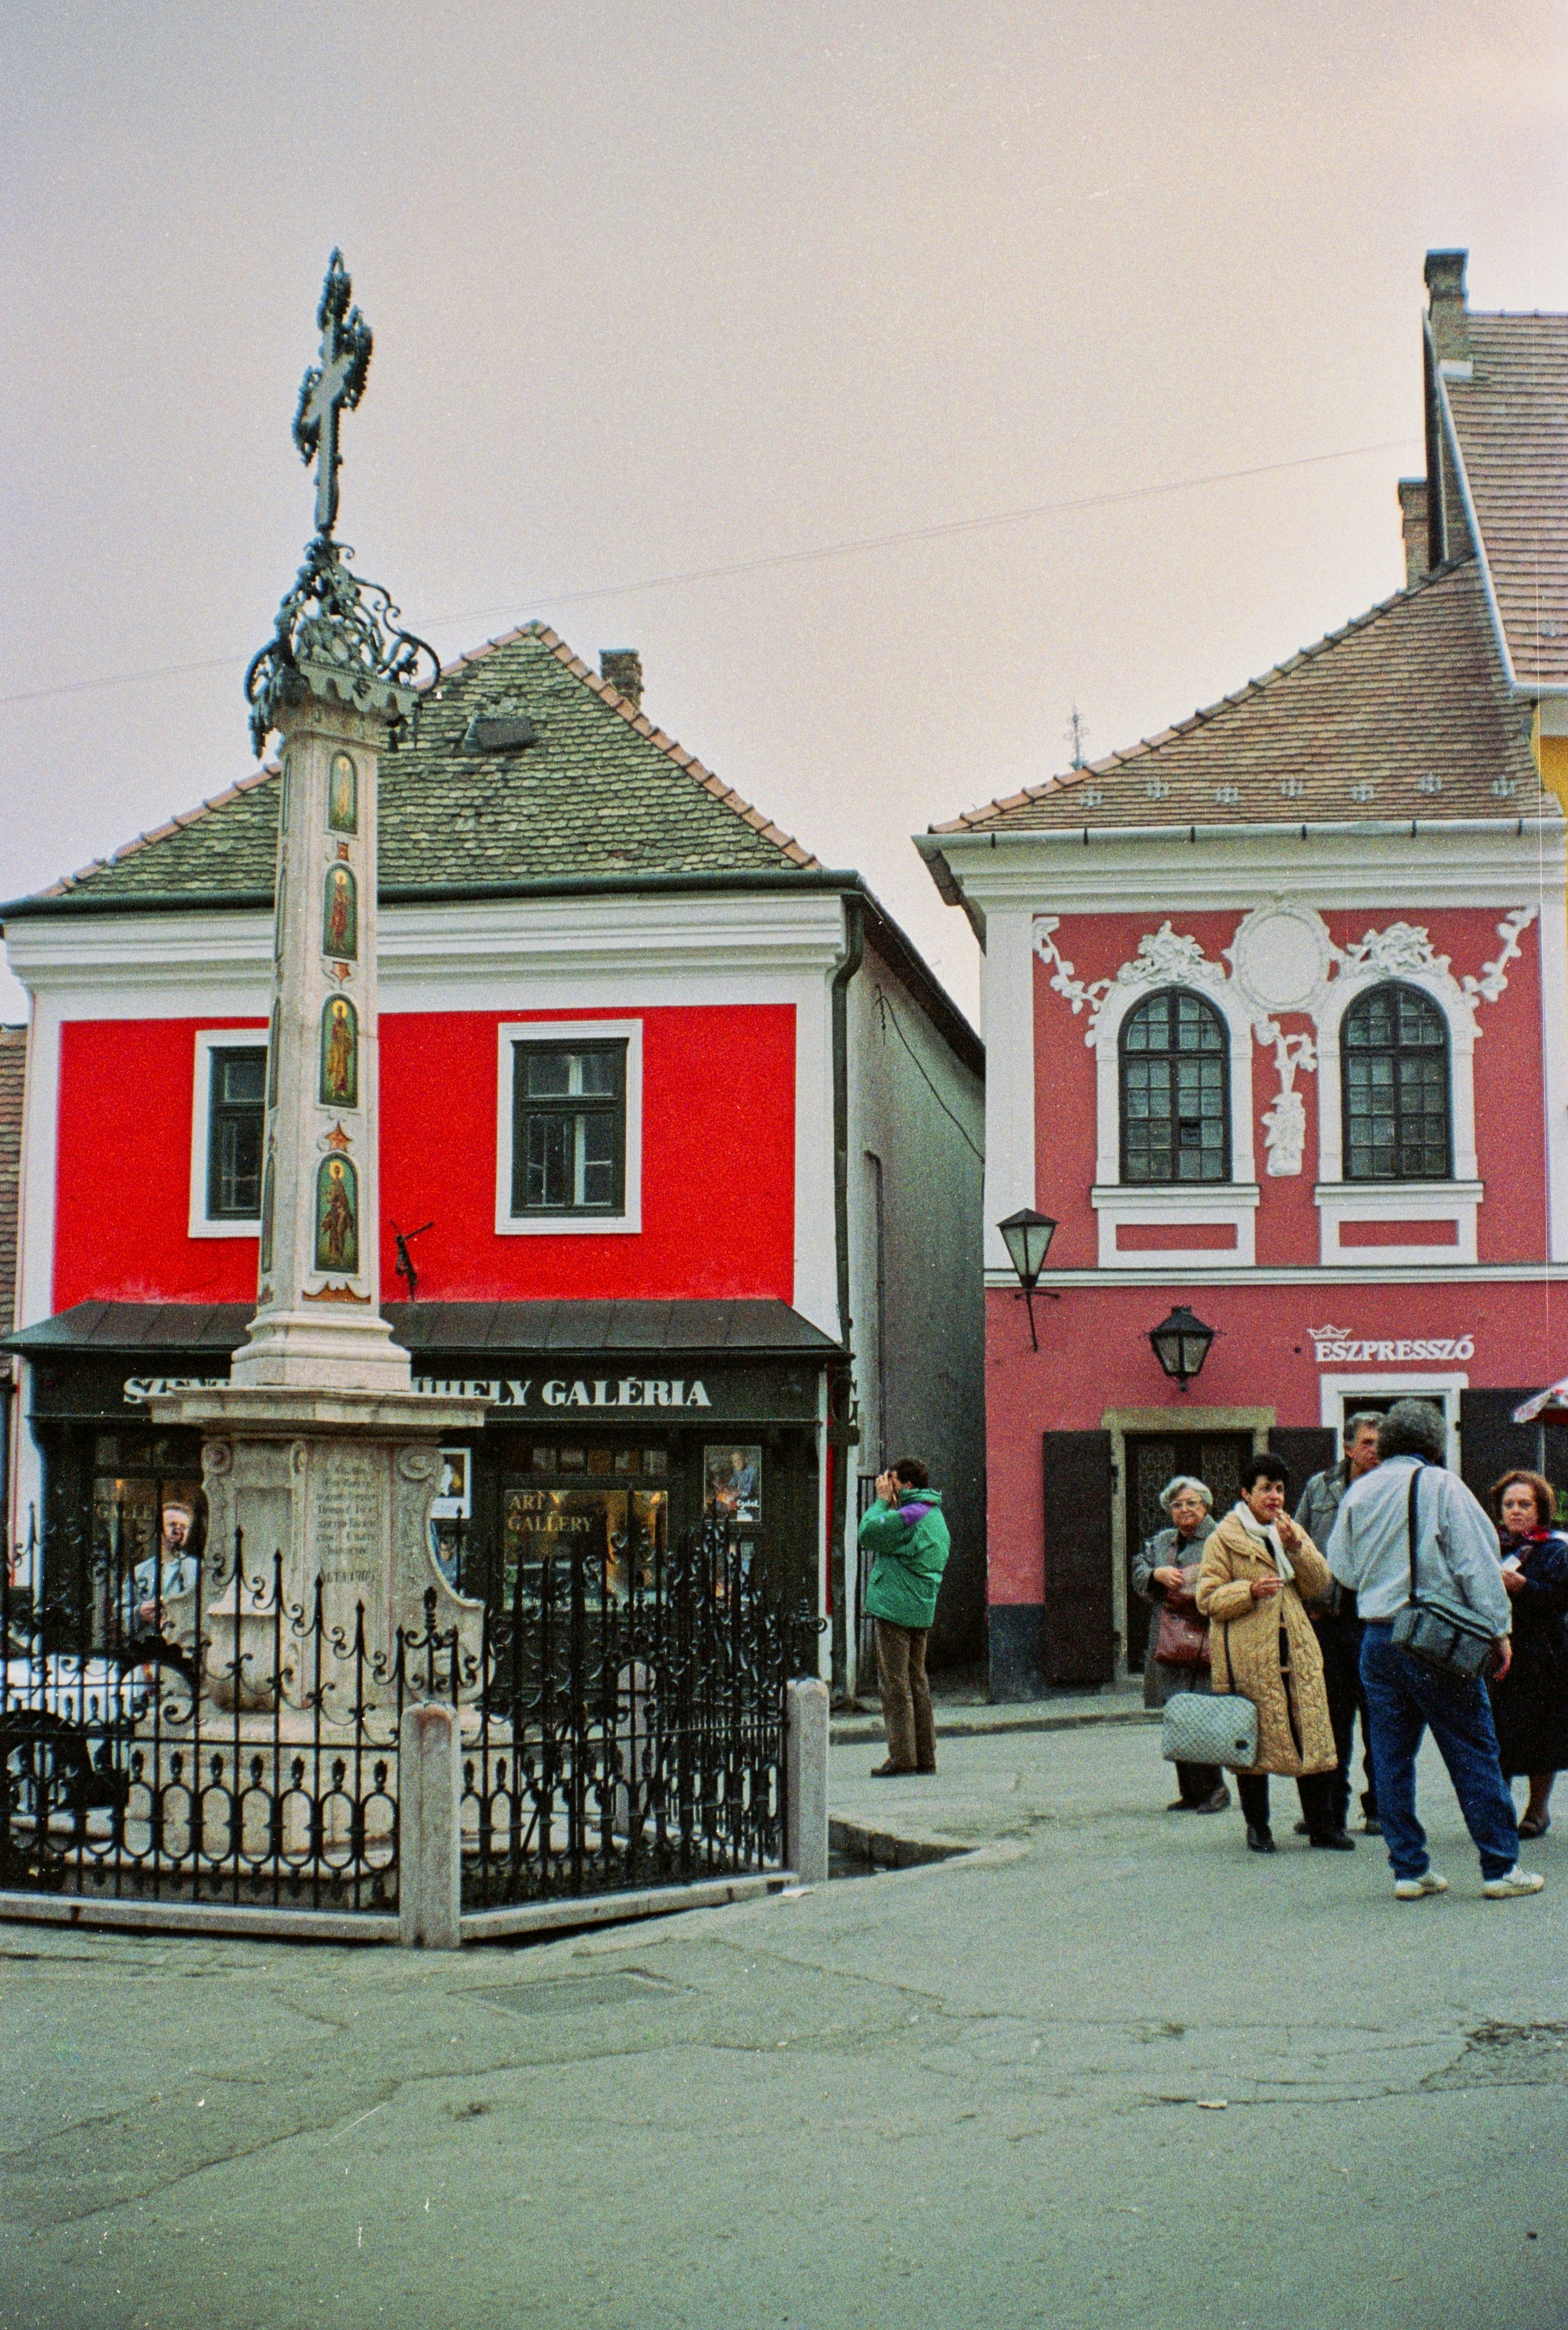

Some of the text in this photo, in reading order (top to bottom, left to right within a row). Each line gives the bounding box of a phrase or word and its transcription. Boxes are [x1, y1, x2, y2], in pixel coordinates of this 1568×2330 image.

[1316, 1334, 1475, 1362] ESZPRESSZÓ
[541, 1377, 712, 1406] GALÉRIA
[509, 1495, 545, 1510] ART
[508, 1516, 593, 1532] GALLERY
